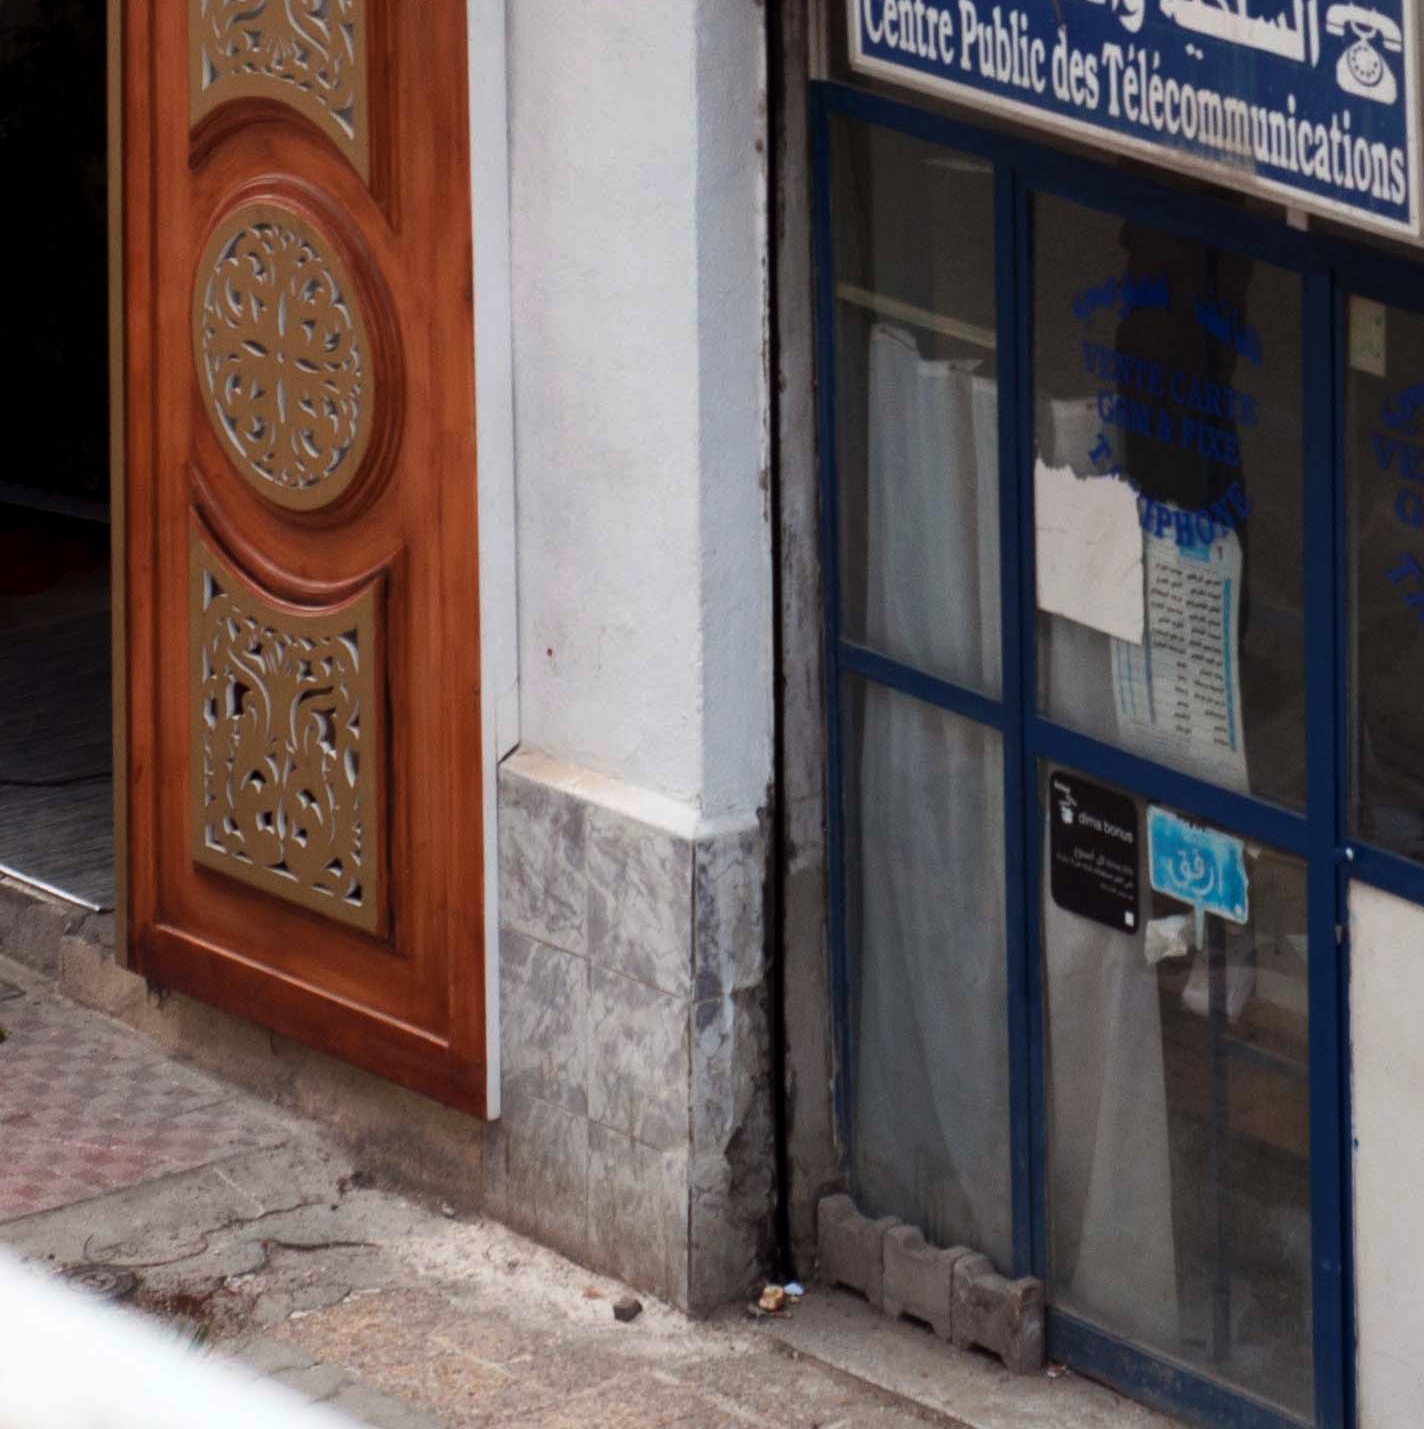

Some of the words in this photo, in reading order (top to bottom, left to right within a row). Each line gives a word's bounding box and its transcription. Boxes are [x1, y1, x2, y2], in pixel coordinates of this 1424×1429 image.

[1051, 25, 1101, 110] des
[1101, 40, 1407, 206] Télécommunications
[1083, 340, 1163, 398] VENTE
[1169, 371, 1260, 428] CARTE
[1096, 389, 1153, 440] GSM
[1156, 408, 1174, 445] &
[1183, 419, 1241, 470] FIXE
